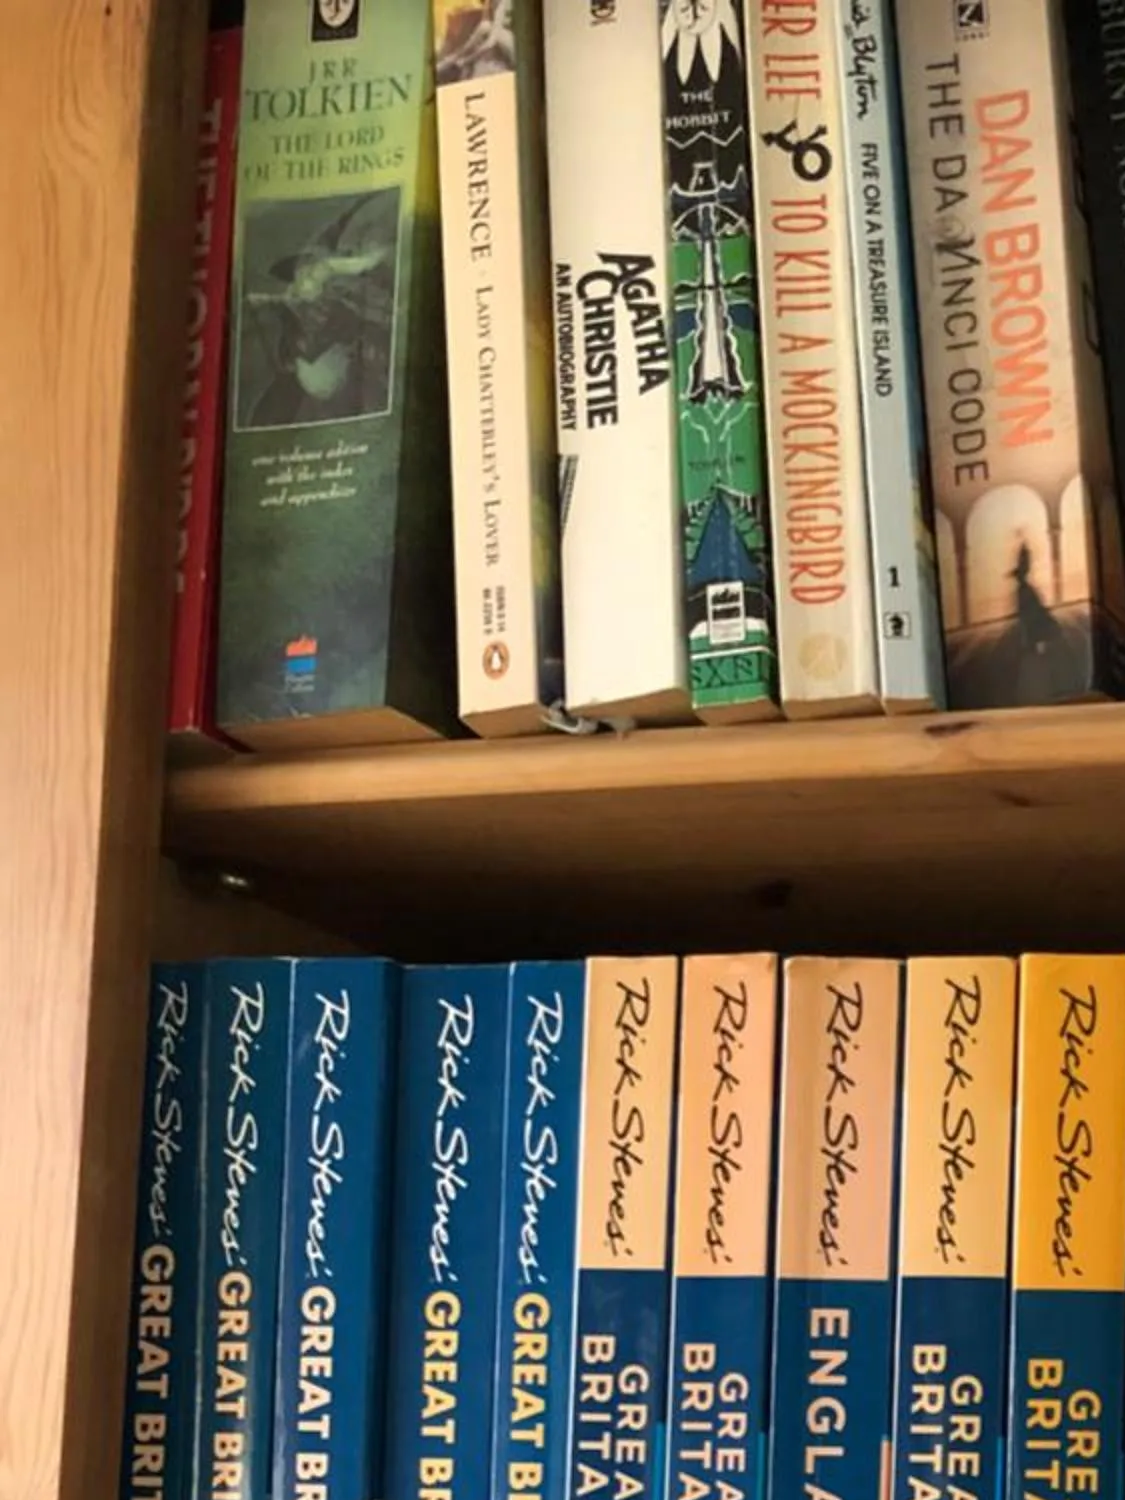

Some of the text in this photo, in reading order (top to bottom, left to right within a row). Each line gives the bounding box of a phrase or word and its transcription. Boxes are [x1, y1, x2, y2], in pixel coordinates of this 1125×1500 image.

[246, 74, 412, 121] TOLKIEN
[666, 110, 730, 128] HOBBIT
[681, 89, 713, 103] THE
[464, 92, 494, 261] LAWRENCE
[861, 143, 879, 178] FIVE
[864, 184, 879, 213] ON
[475, 286, 494, 340] LADY
[598, 252, 671, 395] AGATHA
[867, 238, 889, 331] TREASURE
[926, 56, 990, 486] THE DA VINCI CODE
[976, 90, 1055, 448] DAN BROWN
[555, 264, 578, 431] AN AUTOBIOGRAPHY
[577, 270, 619, 427] CHRISTIE
[772, 195, 845, 604] TO KILL A MOCKINGBIRD
[873, 332, 893, 396] ISLAND
[484, 499, 501, 567] LOVER
[315, 990, 349, 1112] Rick
[297, 1286, 337, 1440] GREAT
[420, 1290, 461, 1444] GREAT
